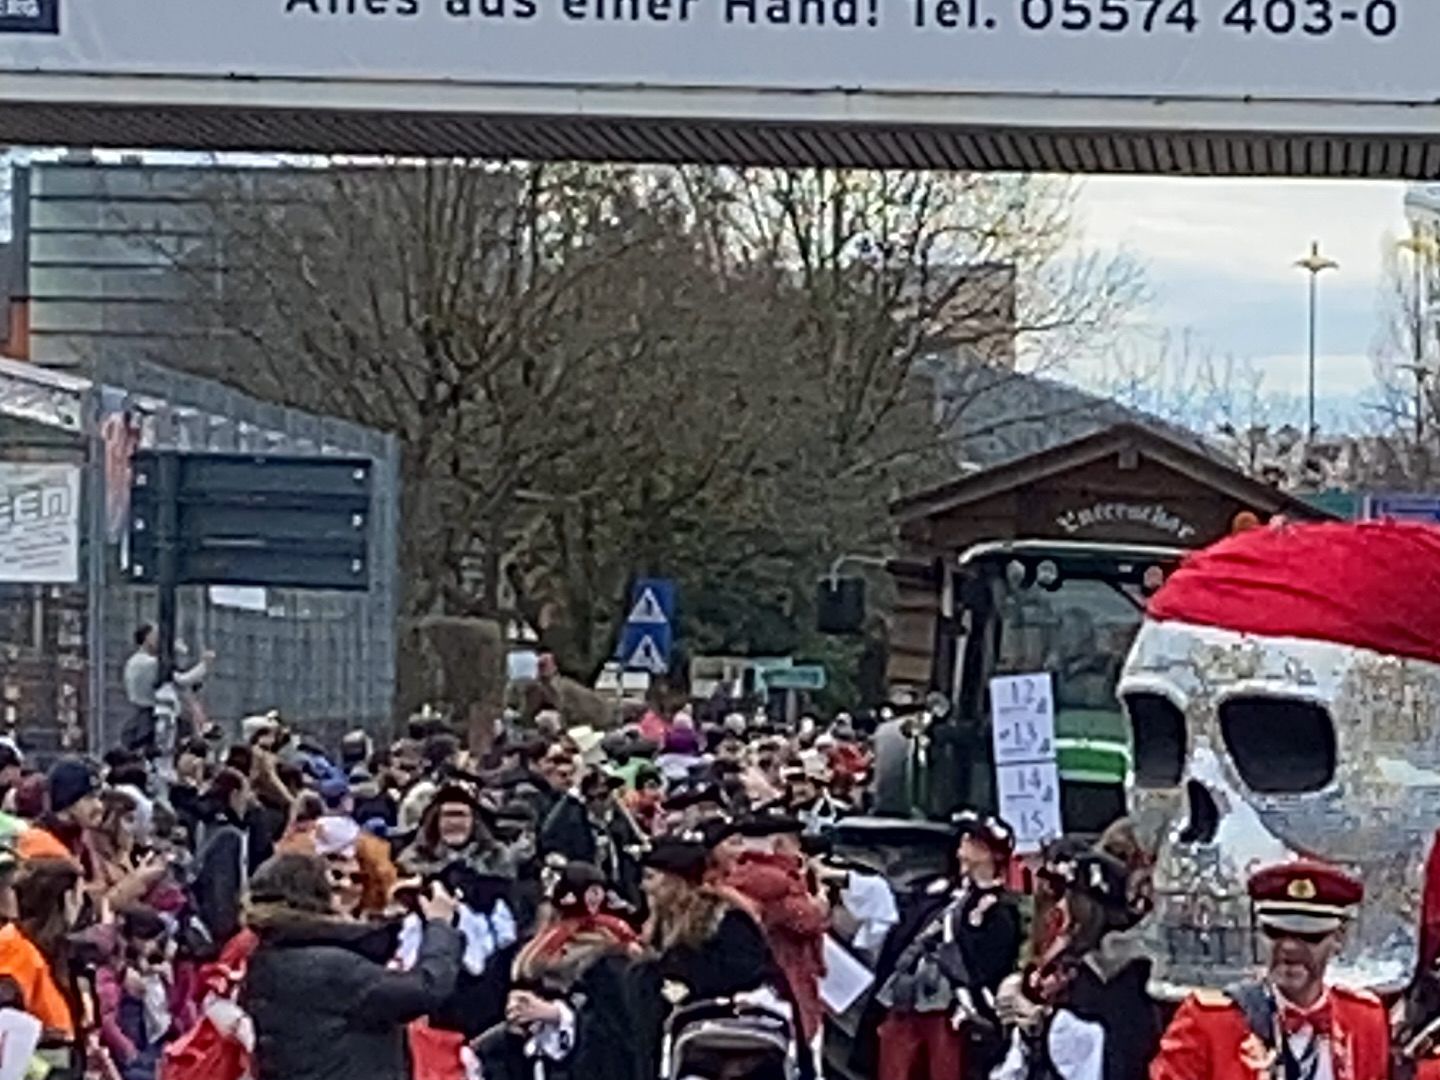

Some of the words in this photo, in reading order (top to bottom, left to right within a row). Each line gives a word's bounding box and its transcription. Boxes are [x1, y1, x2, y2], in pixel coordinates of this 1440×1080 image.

[724, 0, 878, 27] Hand!
[1020, 0, 1198, 33] 05574
[1223, 0, 1398, 36] 403-0
